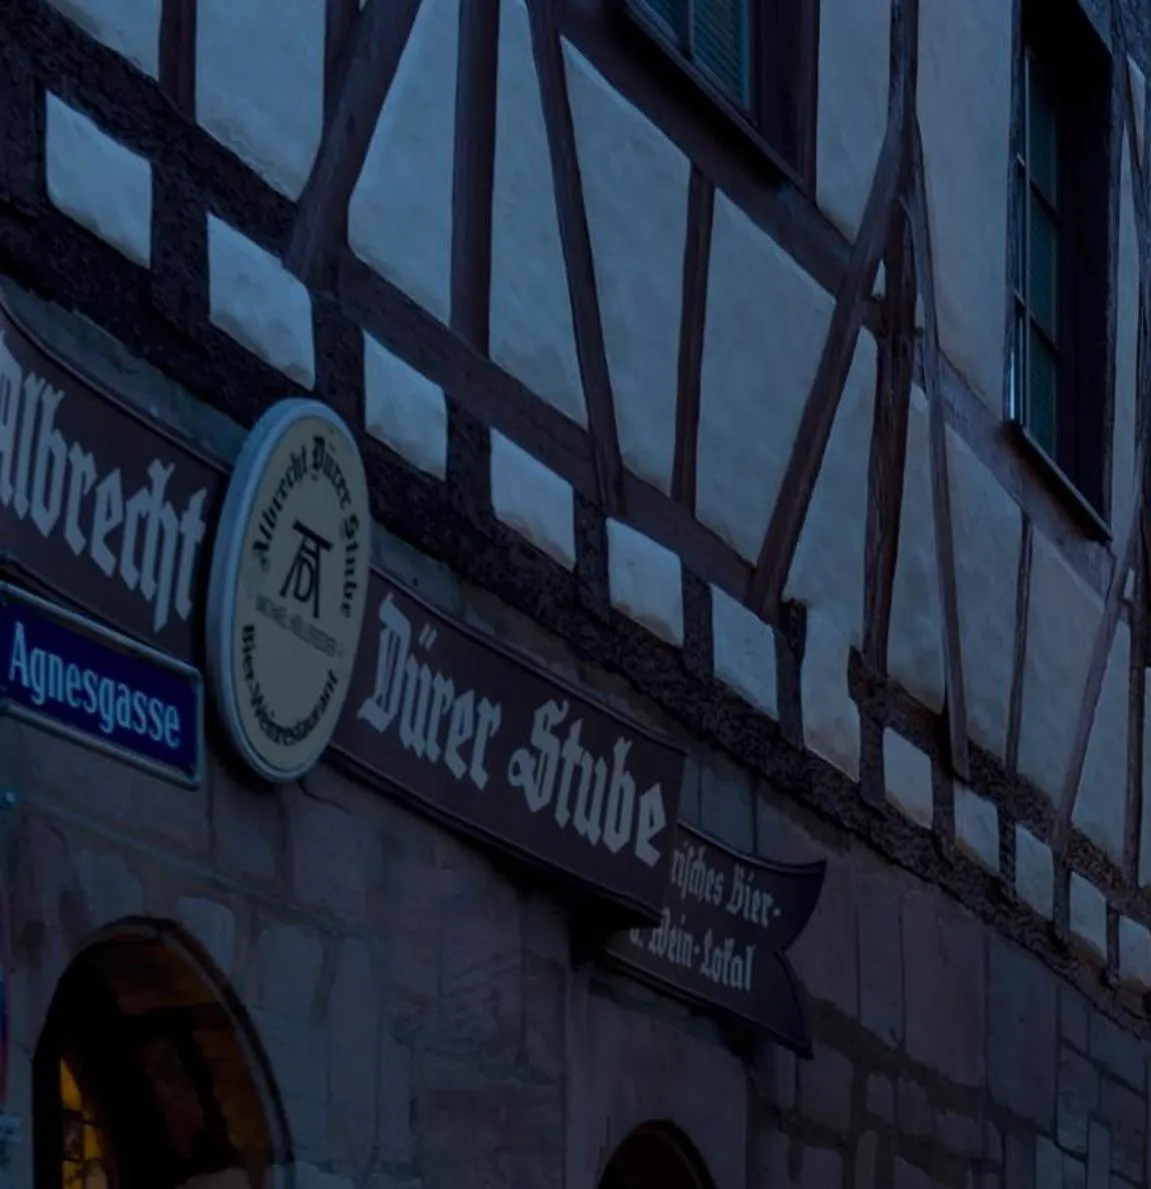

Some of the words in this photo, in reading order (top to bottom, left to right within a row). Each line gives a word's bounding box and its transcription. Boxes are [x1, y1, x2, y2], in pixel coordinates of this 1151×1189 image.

[253, 445, 308, 571] Albrecht
[312, 436, 352, 510] Dürer
[340, 514, 360, 619] Stube
[8, 621, 182, 749] Agnesgasse
[357, 592, 502, 790] Dürer
[508, 698, 667, 868] Stube
[671, 840, 725, 906] risches
